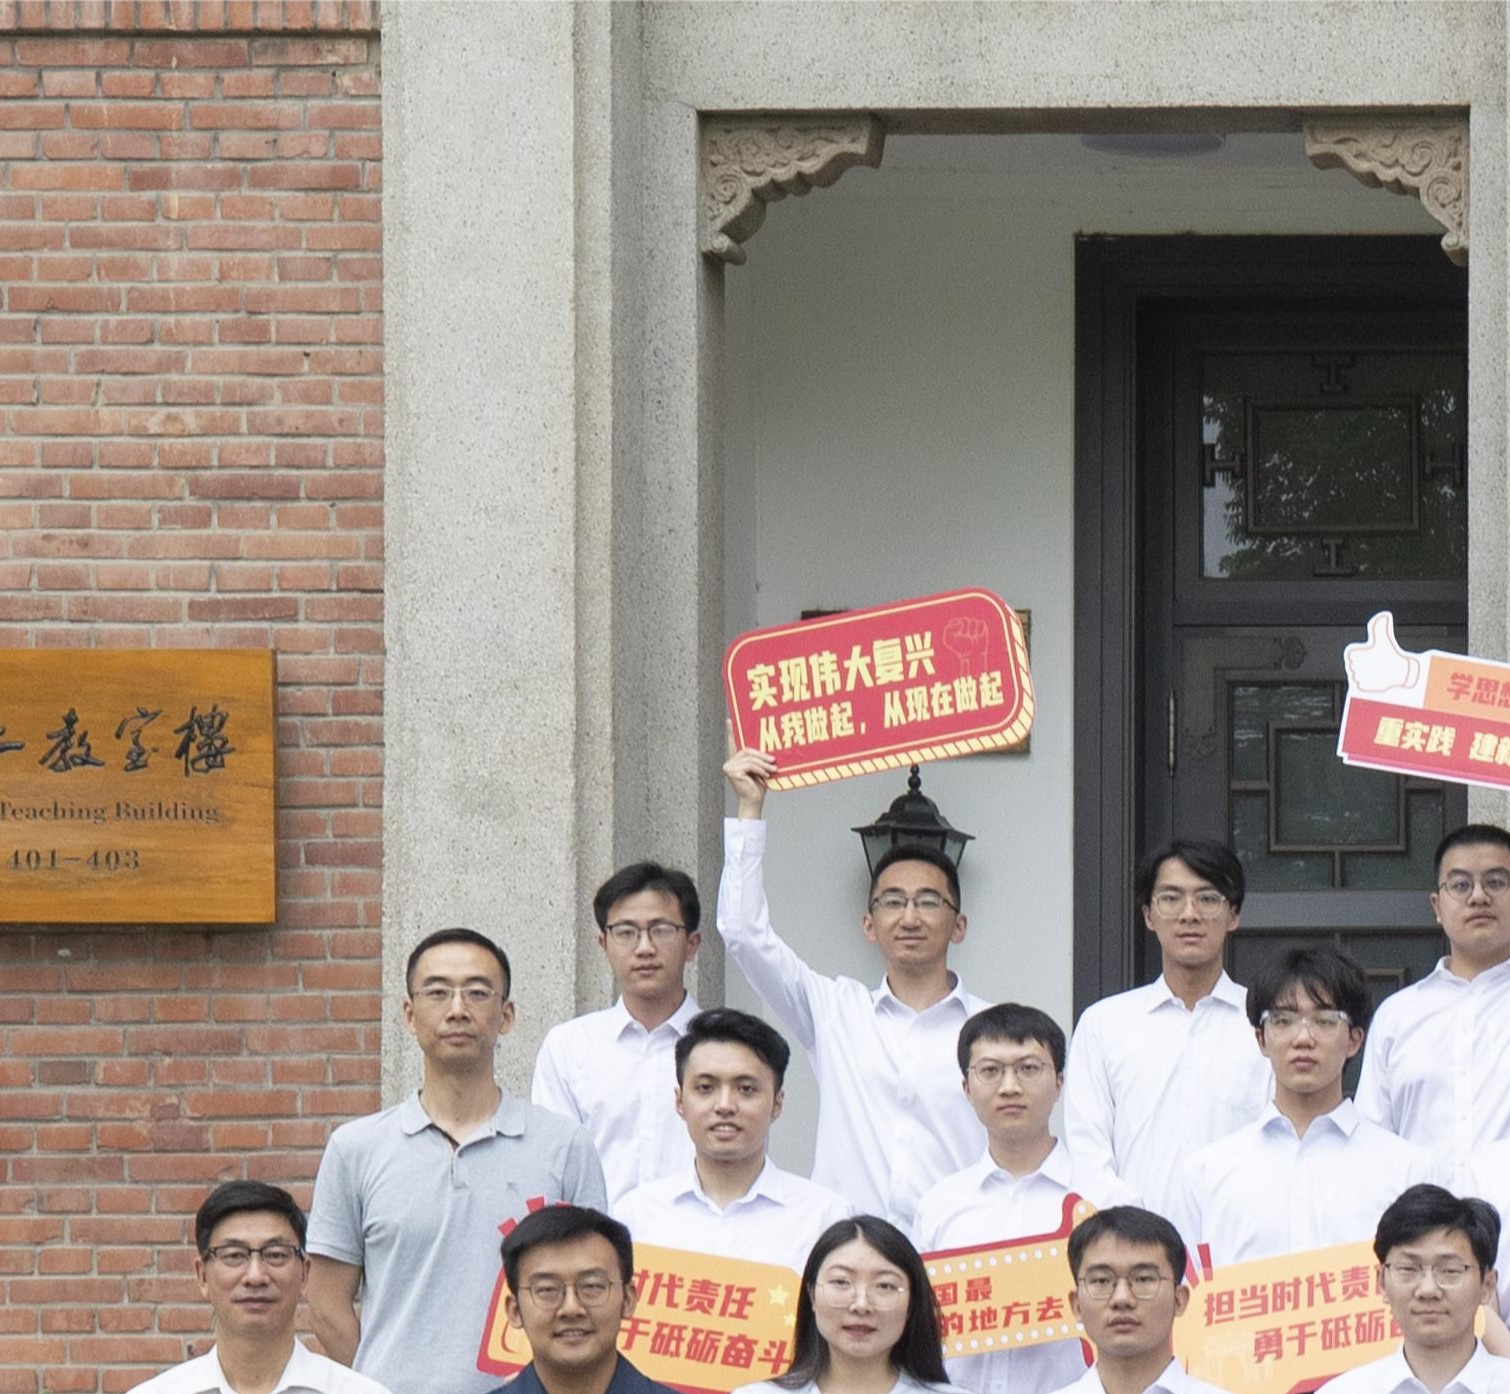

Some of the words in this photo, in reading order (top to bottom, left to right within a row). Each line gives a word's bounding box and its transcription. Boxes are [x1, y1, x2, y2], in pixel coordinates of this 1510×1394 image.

[746, 631, 936, 711] 实现伟大复兴
[1374, 716, 1457, 757] 重实践
[114, 801, 221, 826] Building
